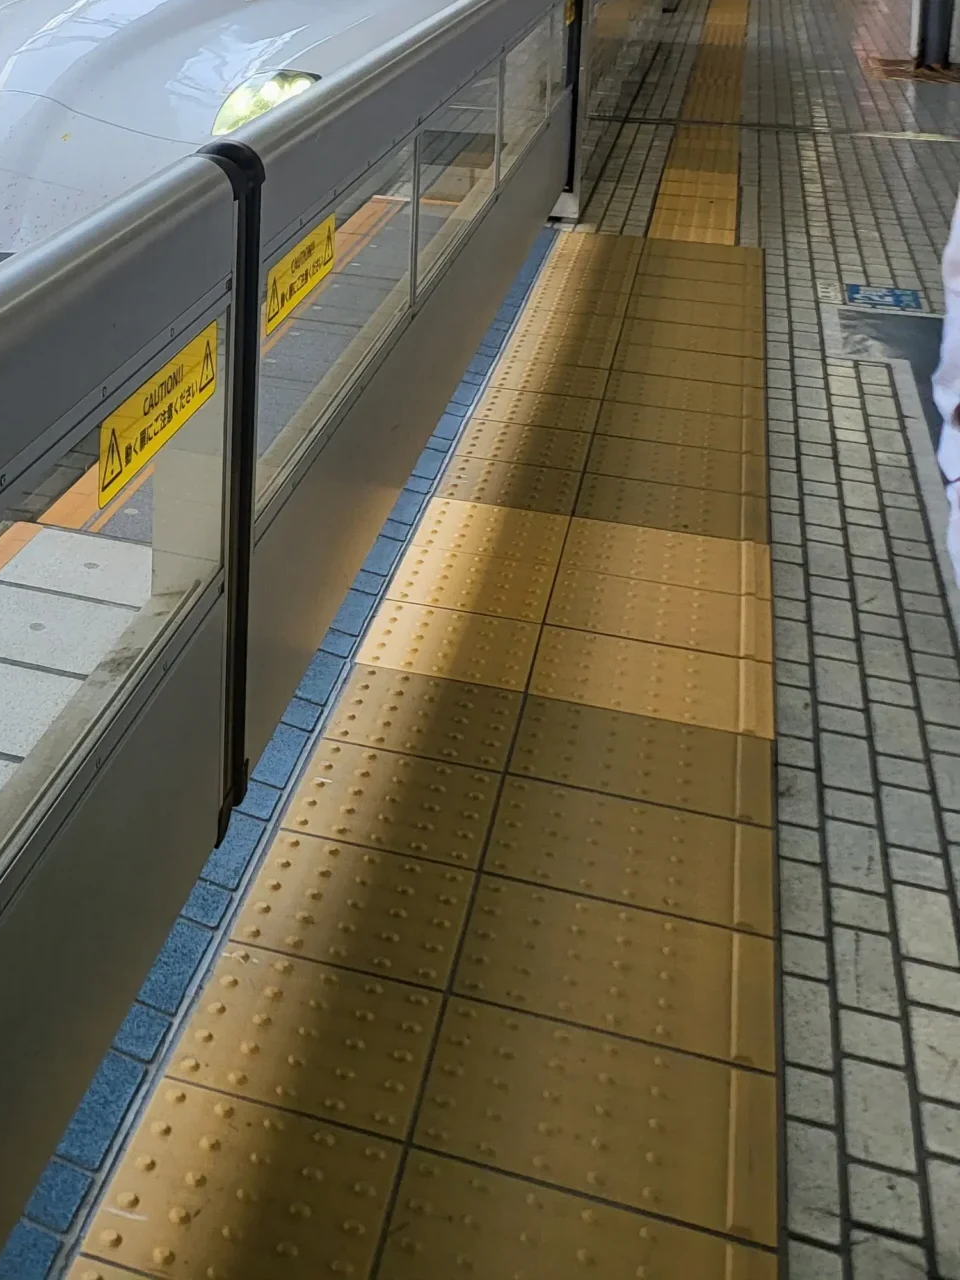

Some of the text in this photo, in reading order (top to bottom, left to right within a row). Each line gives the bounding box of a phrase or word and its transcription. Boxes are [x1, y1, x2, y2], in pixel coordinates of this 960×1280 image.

[124, 379, 198, 468] 動く扉にご注意ください
[143, 364, 184, 417] CAUTION!!
